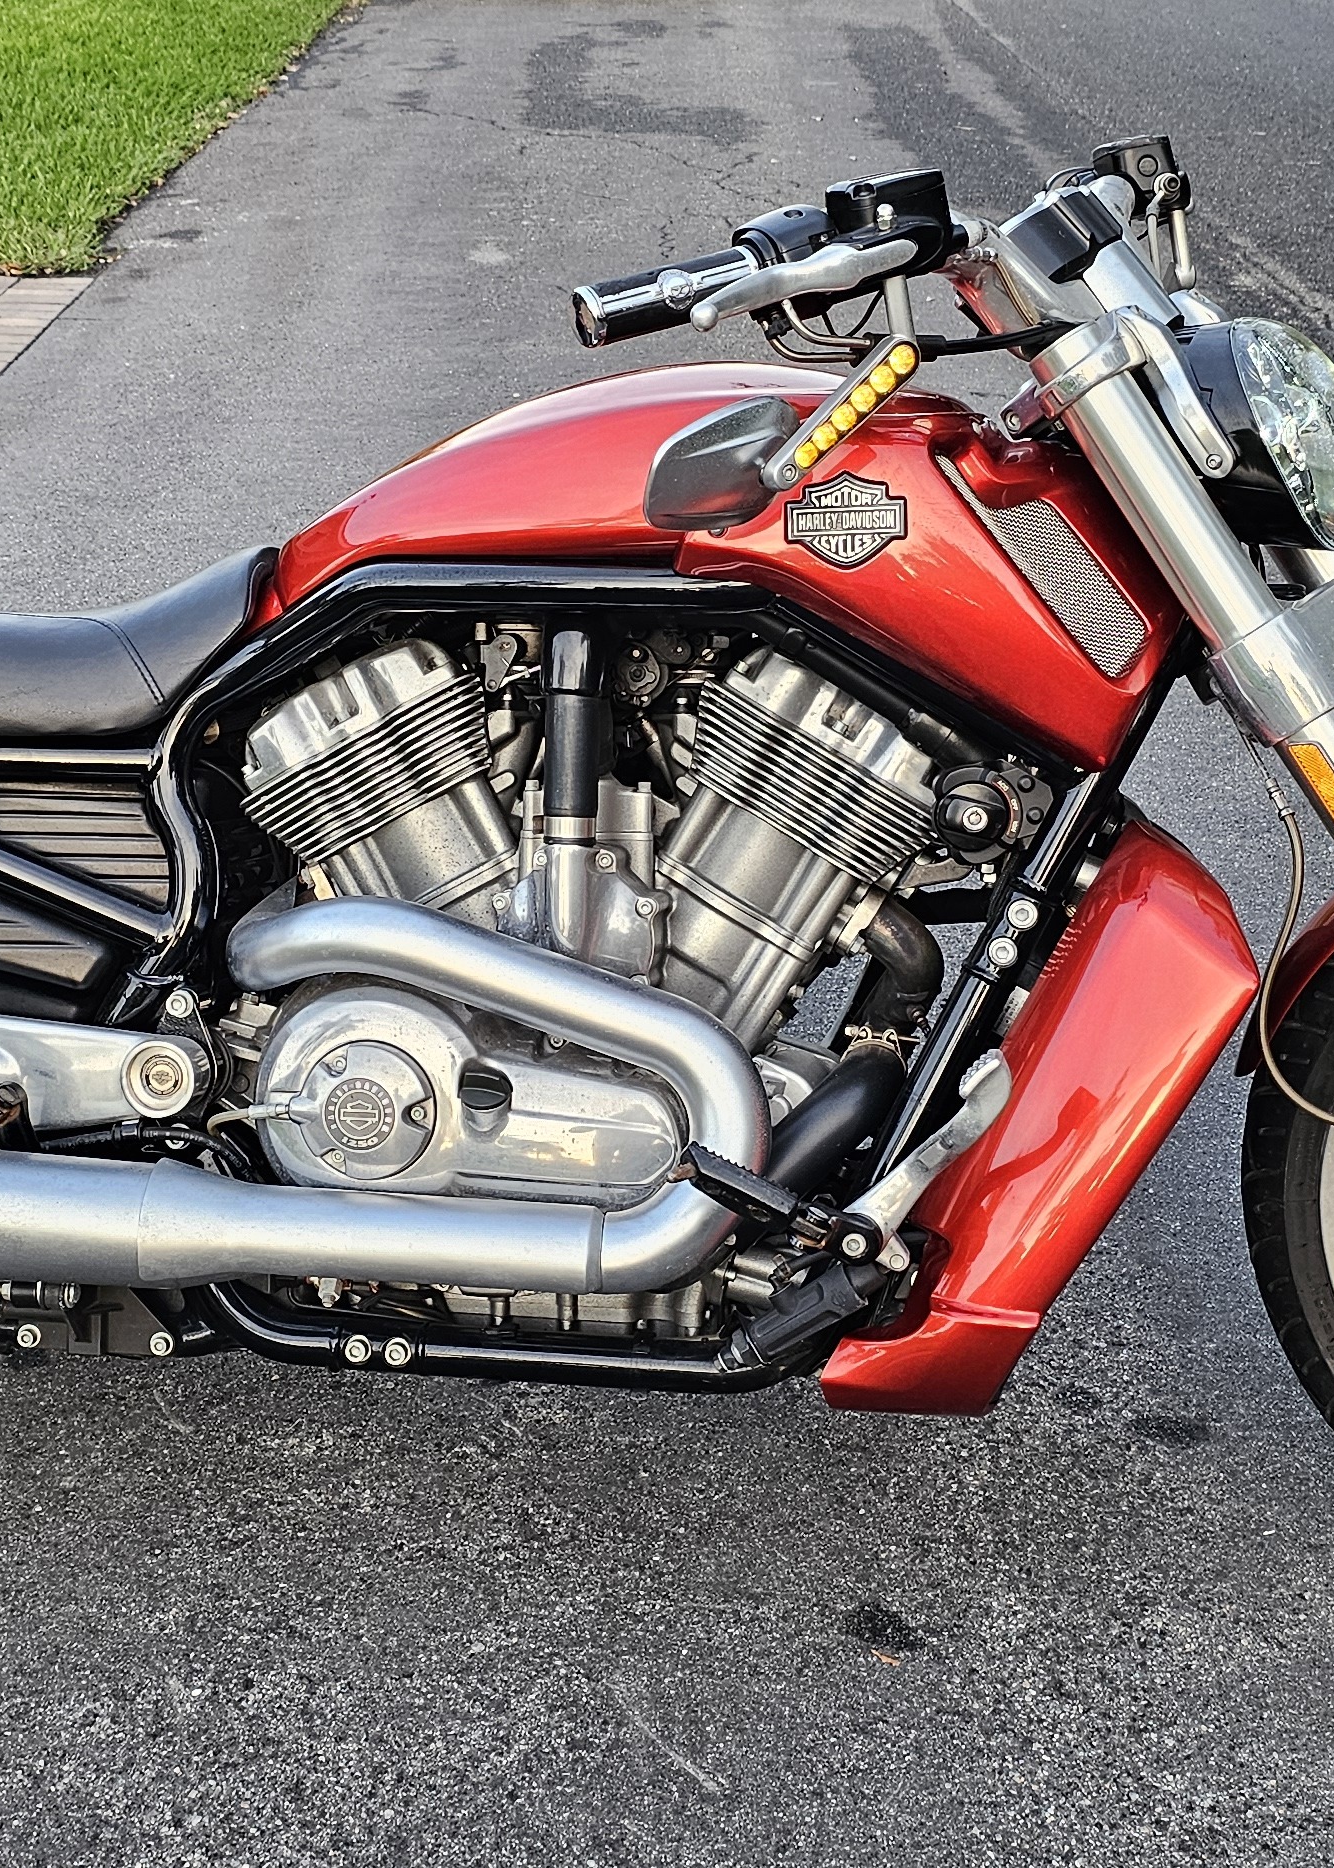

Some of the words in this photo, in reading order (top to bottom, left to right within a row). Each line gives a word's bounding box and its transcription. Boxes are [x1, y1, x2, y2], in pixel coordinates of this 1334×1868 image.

[820, 487, 875, 507] MOTOR
[798, 509, 895, 531] HARLEY-DAVIDSON
[821, 533, 874, 558] CYCLES
[341, 1136, 379, 1148] 1250
